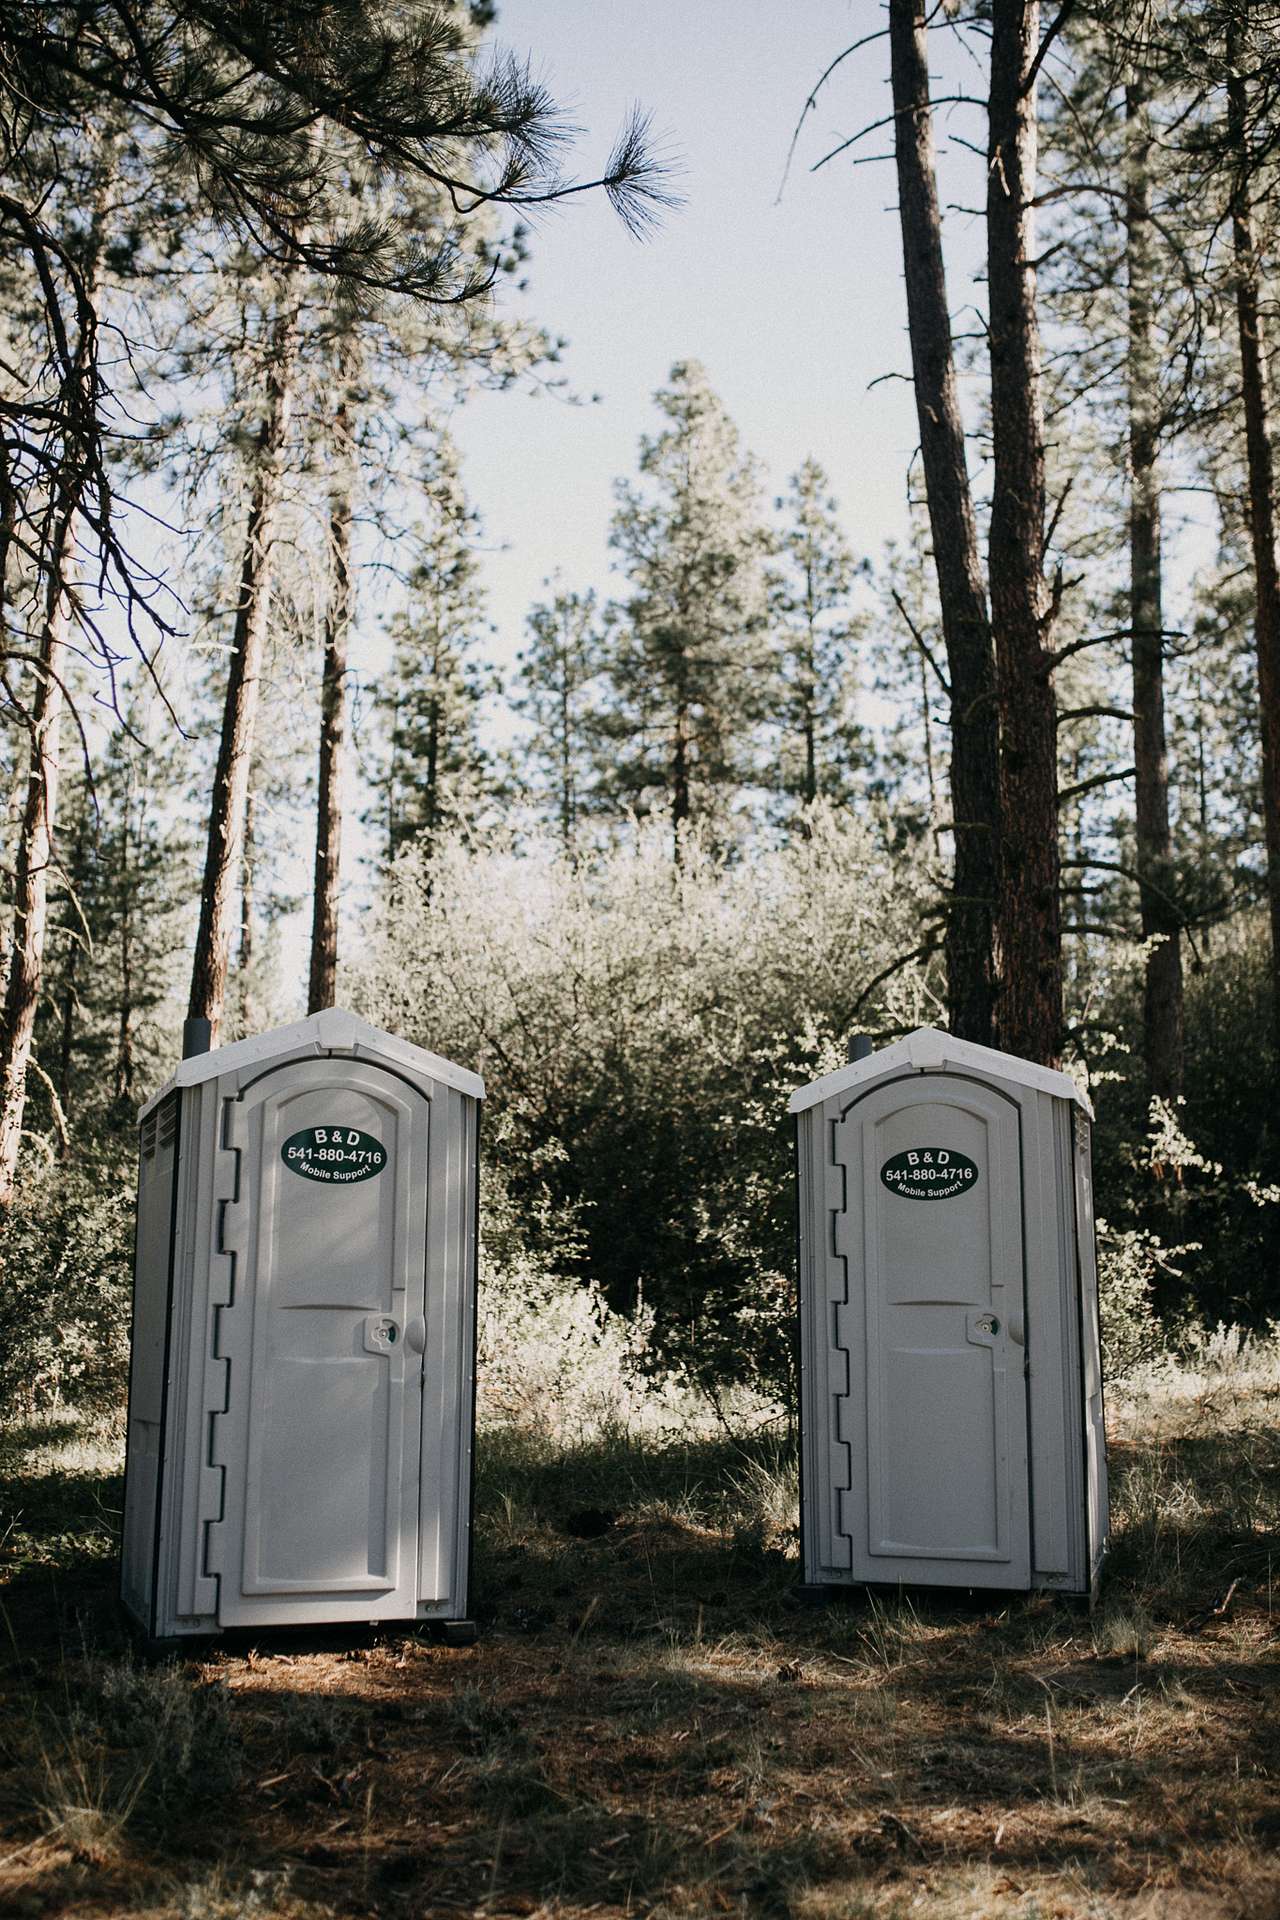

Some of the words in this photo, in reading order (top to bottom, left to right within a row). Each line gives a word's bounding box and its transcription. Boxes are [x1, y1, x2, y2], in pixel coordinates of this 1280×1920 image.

[314, 1129, 327, 1144] B
[331, 1130, 343, 1143] &
[346, 1131, 360, 1146] D
[287, 1146, 382, 1164] 541-880-4716
[907, 1152, 920, 1166] B
[923, 1152, 934, 1163] &
[937, 1151, 950, 1165] D
[299, 1161, 331, 1179] Mobile
[332, 1164, 372, 1181] Support
[885, 1168, 973, 1181] 541-880-4716
[897, 1182, 926, 1197] Mobile
[927, 1180, 963, 1197] Support
